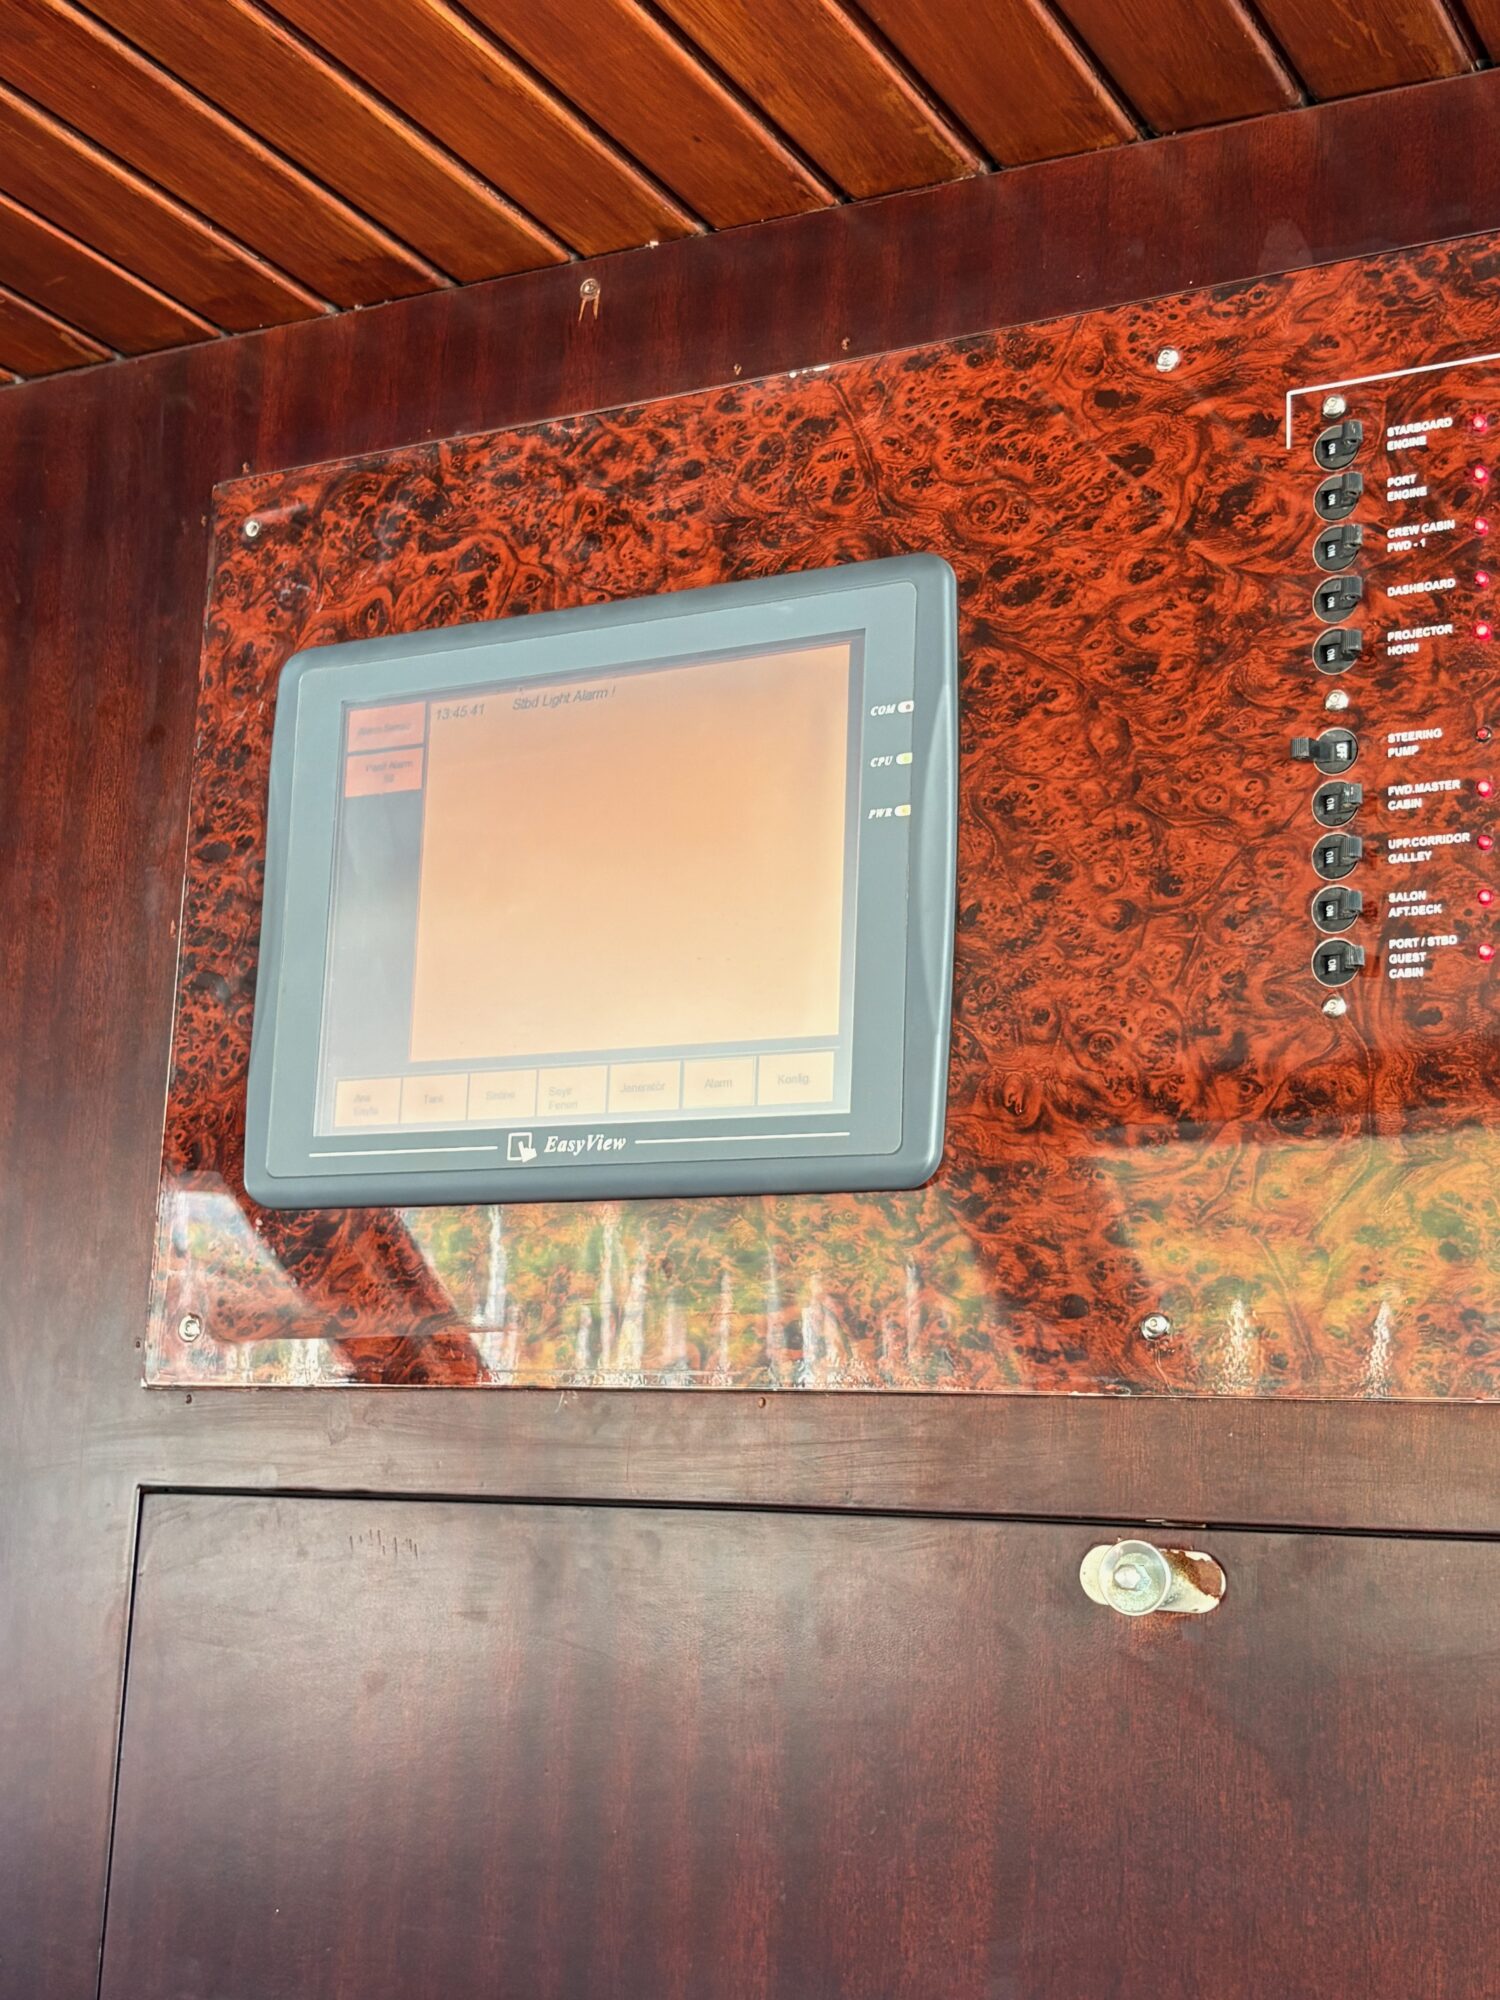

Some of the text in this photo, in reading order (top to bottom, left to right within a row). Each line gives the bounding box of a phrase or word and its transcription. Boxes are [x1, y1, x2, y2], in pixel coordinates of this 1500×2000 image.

[1387, 417, 1453, 437] STARBOARD
[1387, 436, 1427, 451] ENGINE
[1387, 474, 1417, 488] PORT
[1387, 486, 1428, 502] ENGINE
[1387, 519, 1456, 539] CREW CABIN
[1387, 540, 1412, 553] FWD
[1387, 578, 1456, 597] DASHBOARD
[1387, 624, 1454, 643] PROJECTOR
[1387, 643, 1420, 656] HORN
[512, 696, 540, 711] Stbd
[542, 692, 572, 710] Light
[573, 688, 608, 702] Alarm
[870, 703, 896, 716] COM
[1387, 728, 1443, 743] STEERING
[1387, 745, 1420, 758] PUMP
[870, 755, 894, 767] CPU
[1387, 780, 1461, 797] FWD.MASTER
[1387, 798, 1423, 811] CABIN
[868, 807, 893, 820] PWR
[1388, 832, 1470, 850] UPP.CORRIDOR
[1388, 851, 1432, 864] GALLEY
[1388, 890, 1427, 903] SALON
[1388, 903, 1443, 918] AFT.DECK
[1388, 937, 1420, 950] PORT
[1427, 934, 1458, 947] STBD
[1388, 951, 1427, 965] GUEST
[1388, 966, 1424, 979] CABIN
[544, 1133, 626, 1156] EasyView
